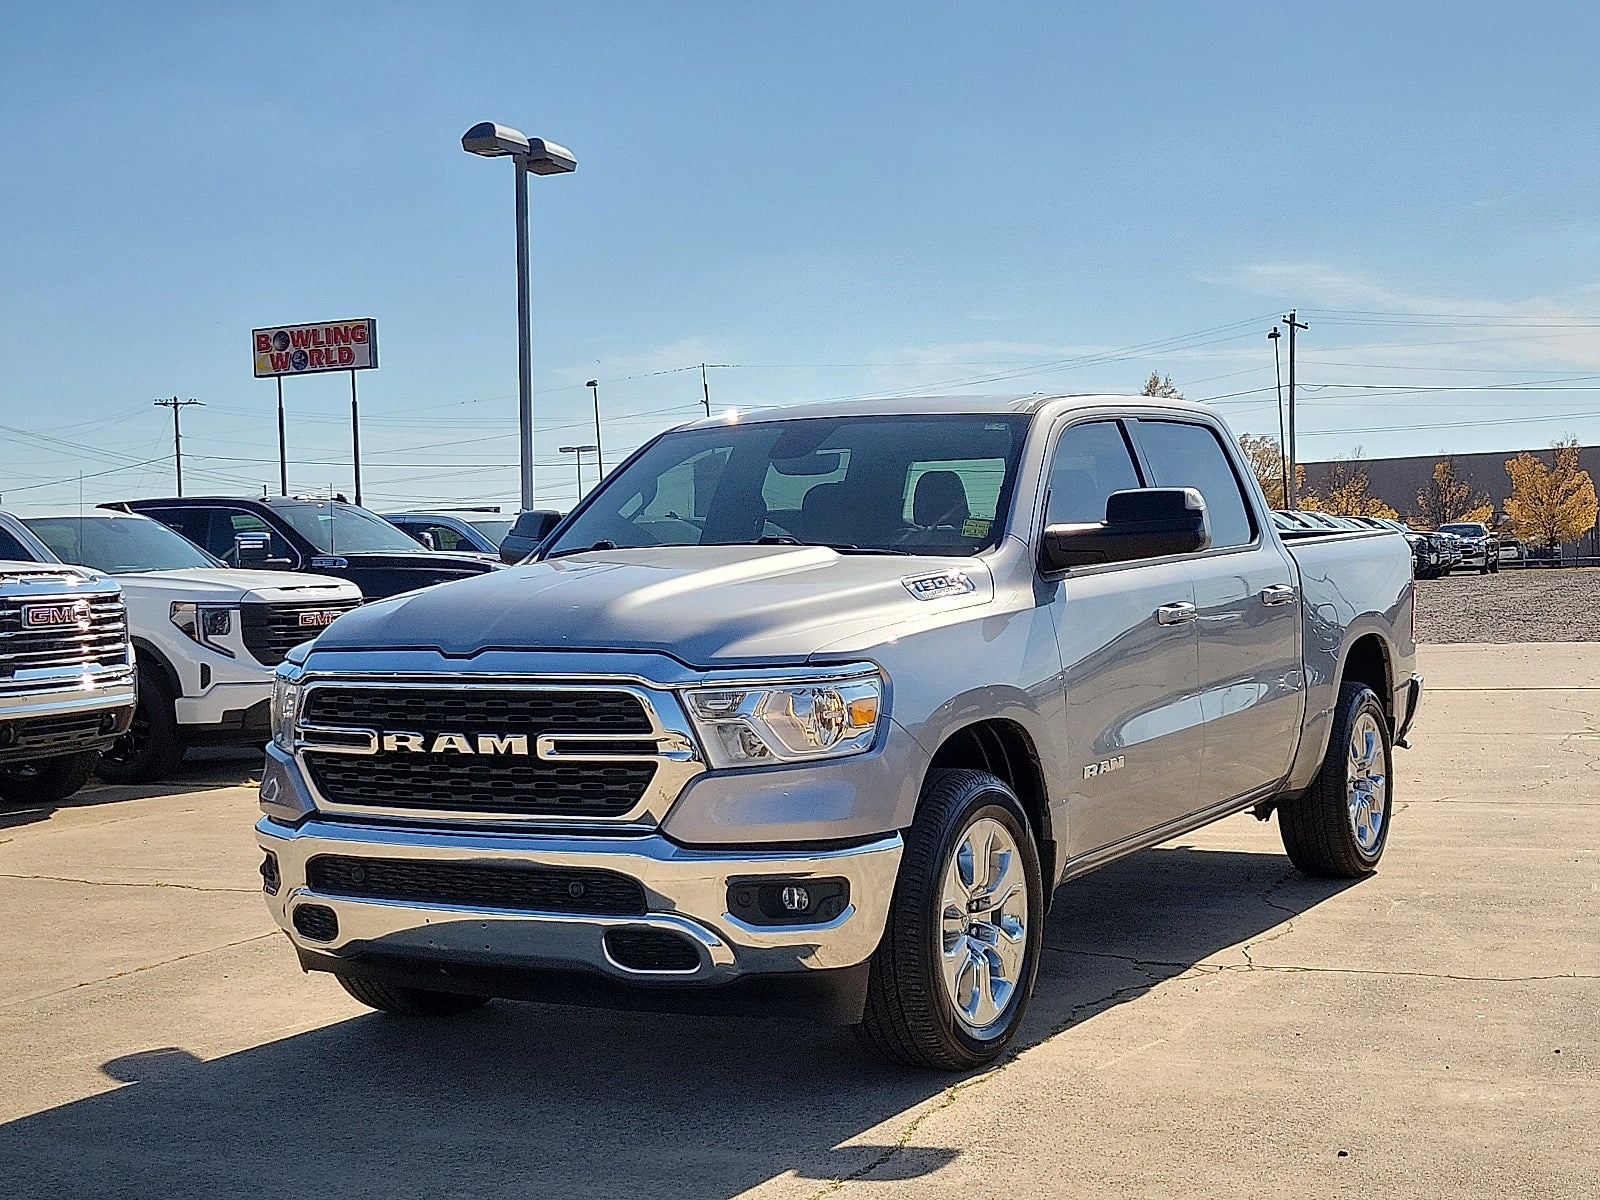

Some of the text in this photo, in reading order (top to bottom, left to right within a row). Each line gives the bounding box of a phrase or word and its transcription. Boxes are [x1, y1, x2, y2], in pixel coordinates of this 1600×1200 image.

[256, 325, 368, 353] BOWLING
[269, 346, 355, 372] WORLD
[28, 604, 89, 624] GMC
[383, 730, 528, 756] RAM
[1083, 755, 1125, 779] RAM
